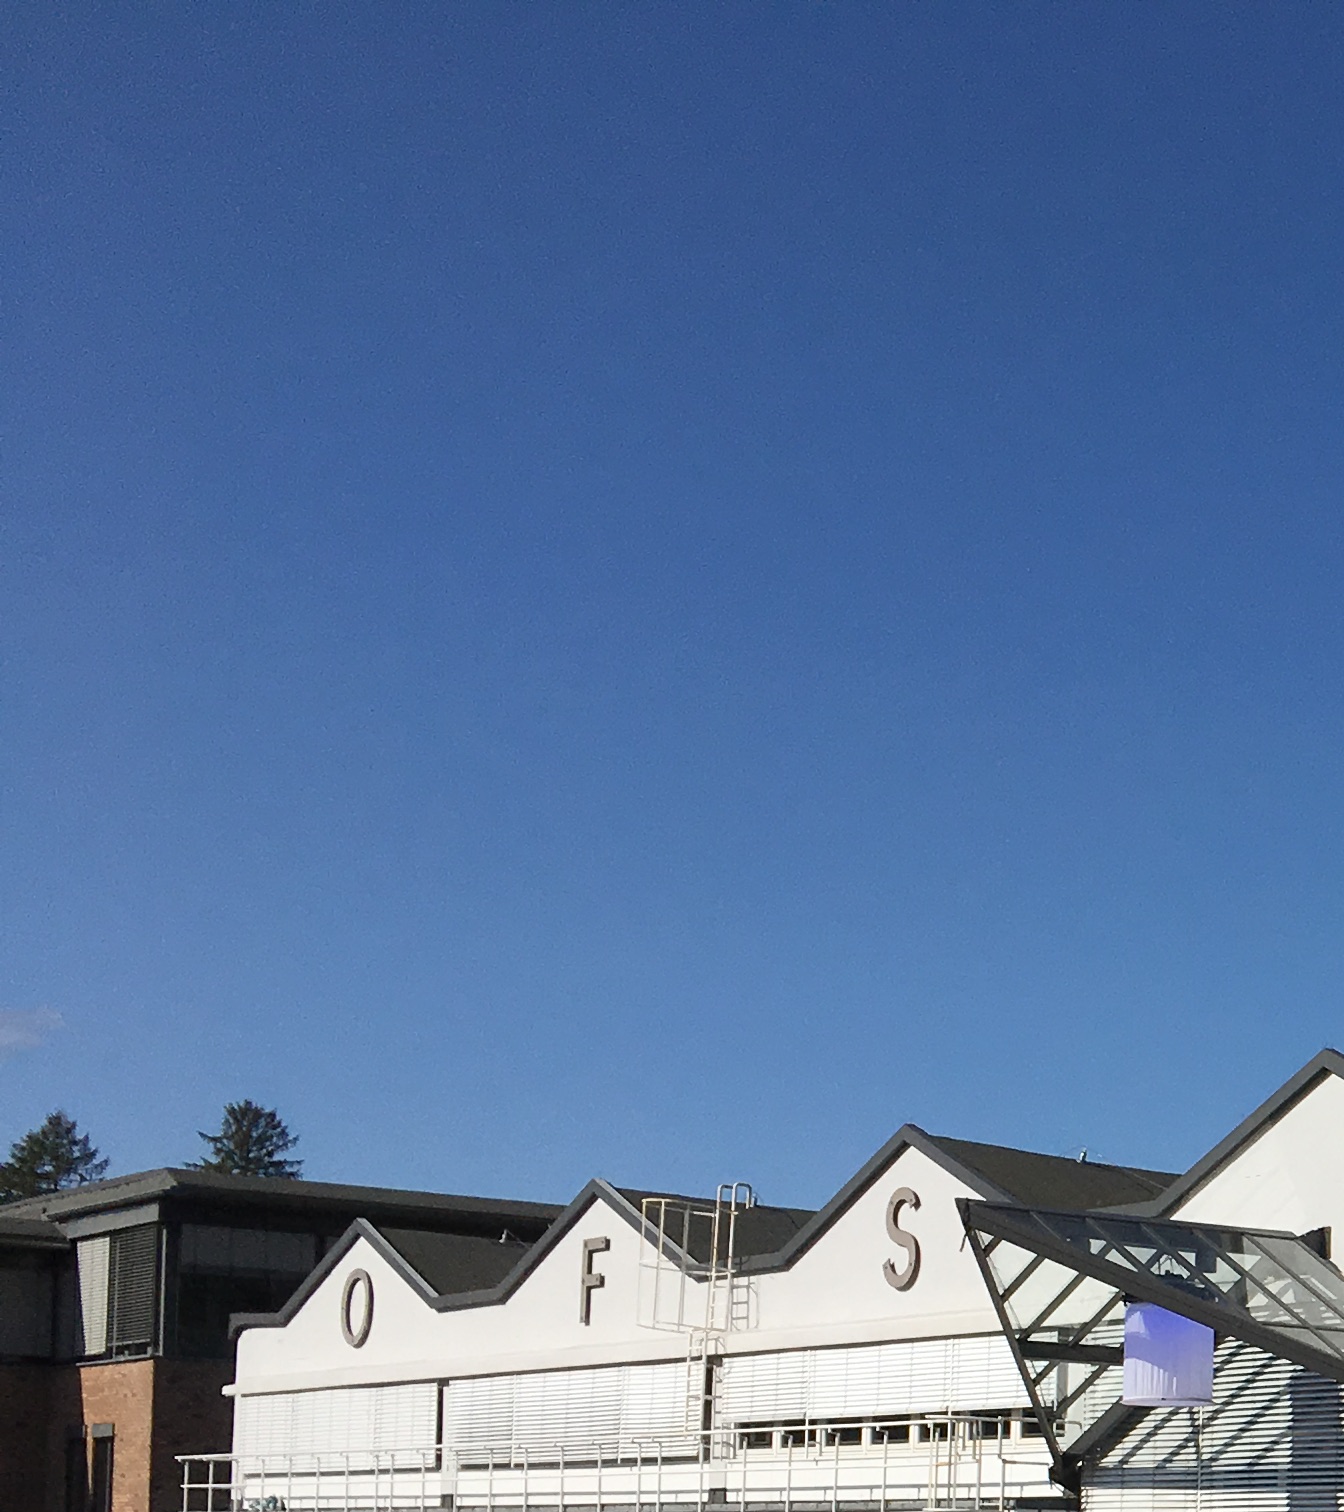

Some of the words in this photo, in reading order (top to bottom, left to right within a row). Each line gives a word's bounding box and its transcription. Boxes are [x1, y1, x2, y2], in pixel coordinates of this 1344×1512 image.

[341, 1267, 374, 1349] O
[579, 1236, 611, 1326] F
[882, 1186, 921, 1292] S
